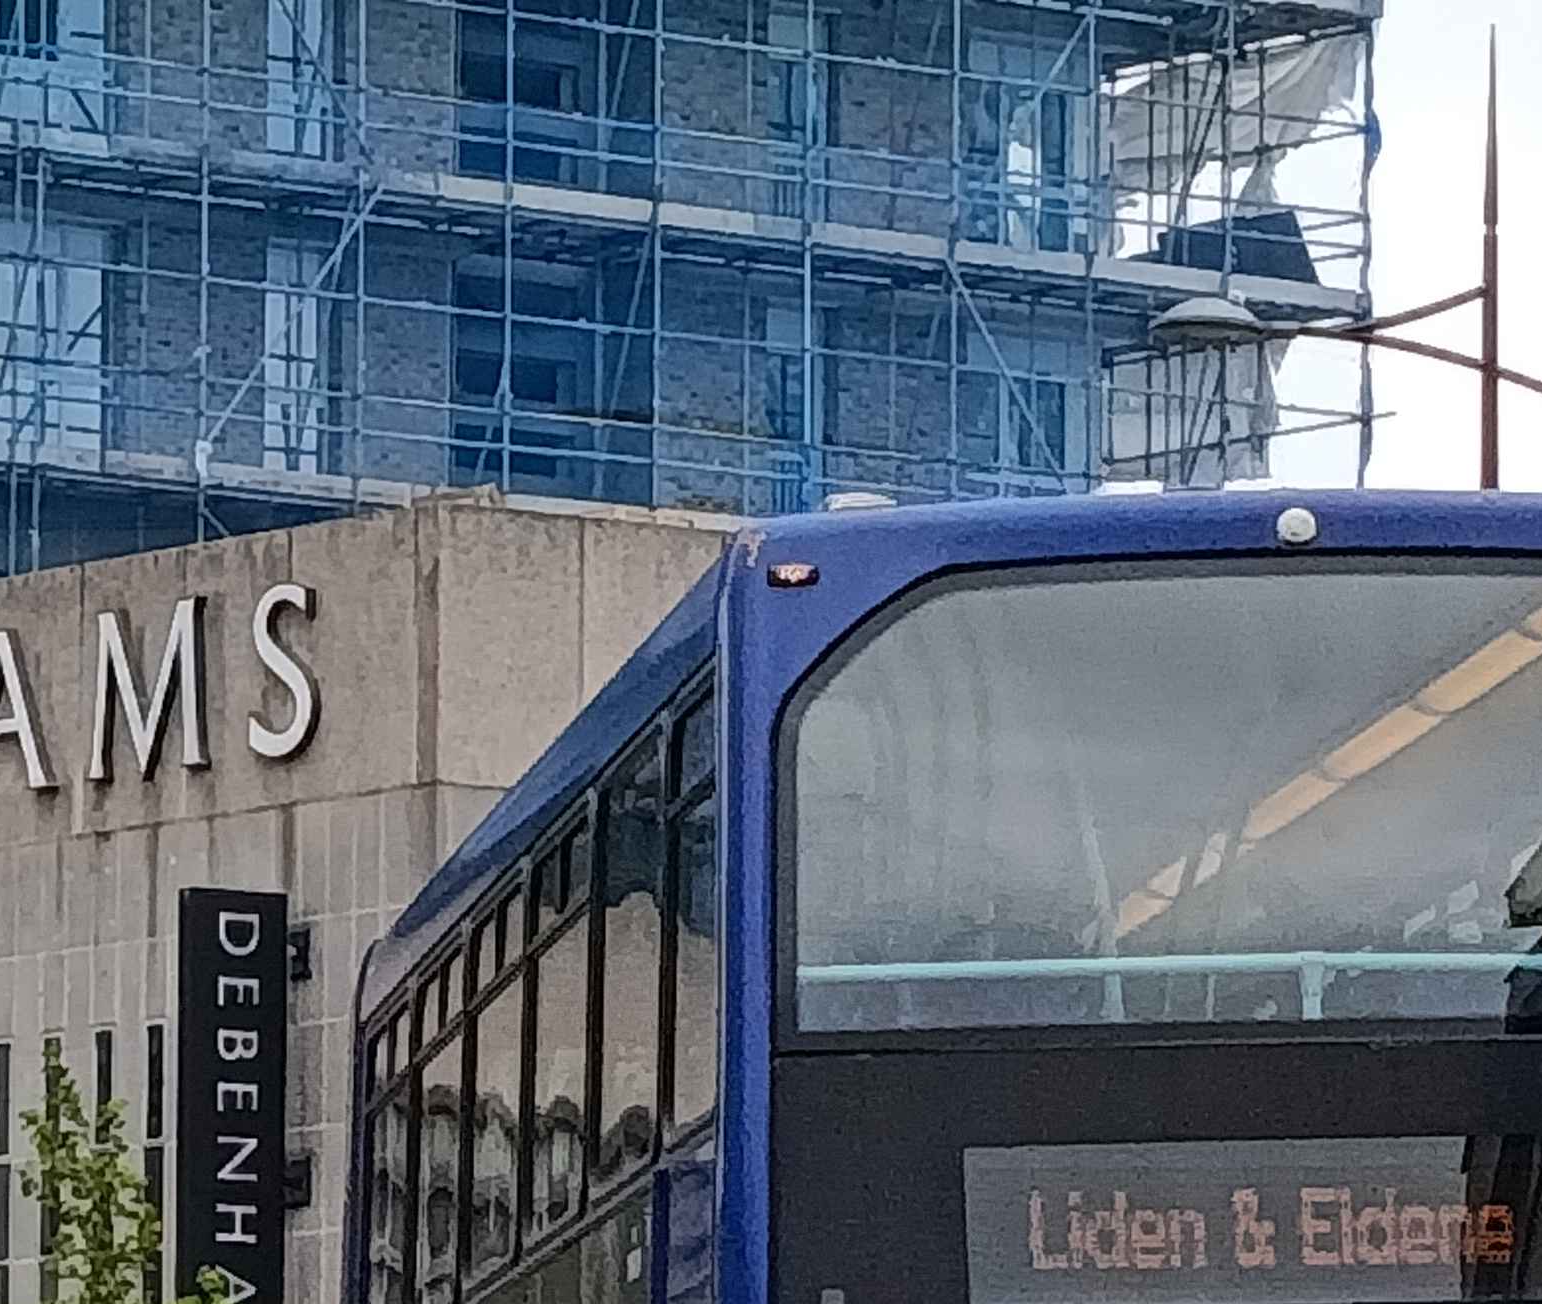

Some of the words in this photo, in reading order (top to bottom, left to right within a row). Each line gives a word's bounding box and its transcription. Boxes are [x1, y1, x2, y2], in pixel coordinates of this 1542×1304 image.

[215, 911, 260, 1303] DEBENHA
[1029, 1189, 1206, 1270] Liden
[1233, 1188, 1276, 1267] &
[1300, 1188, 1514, 1266] Eldene
